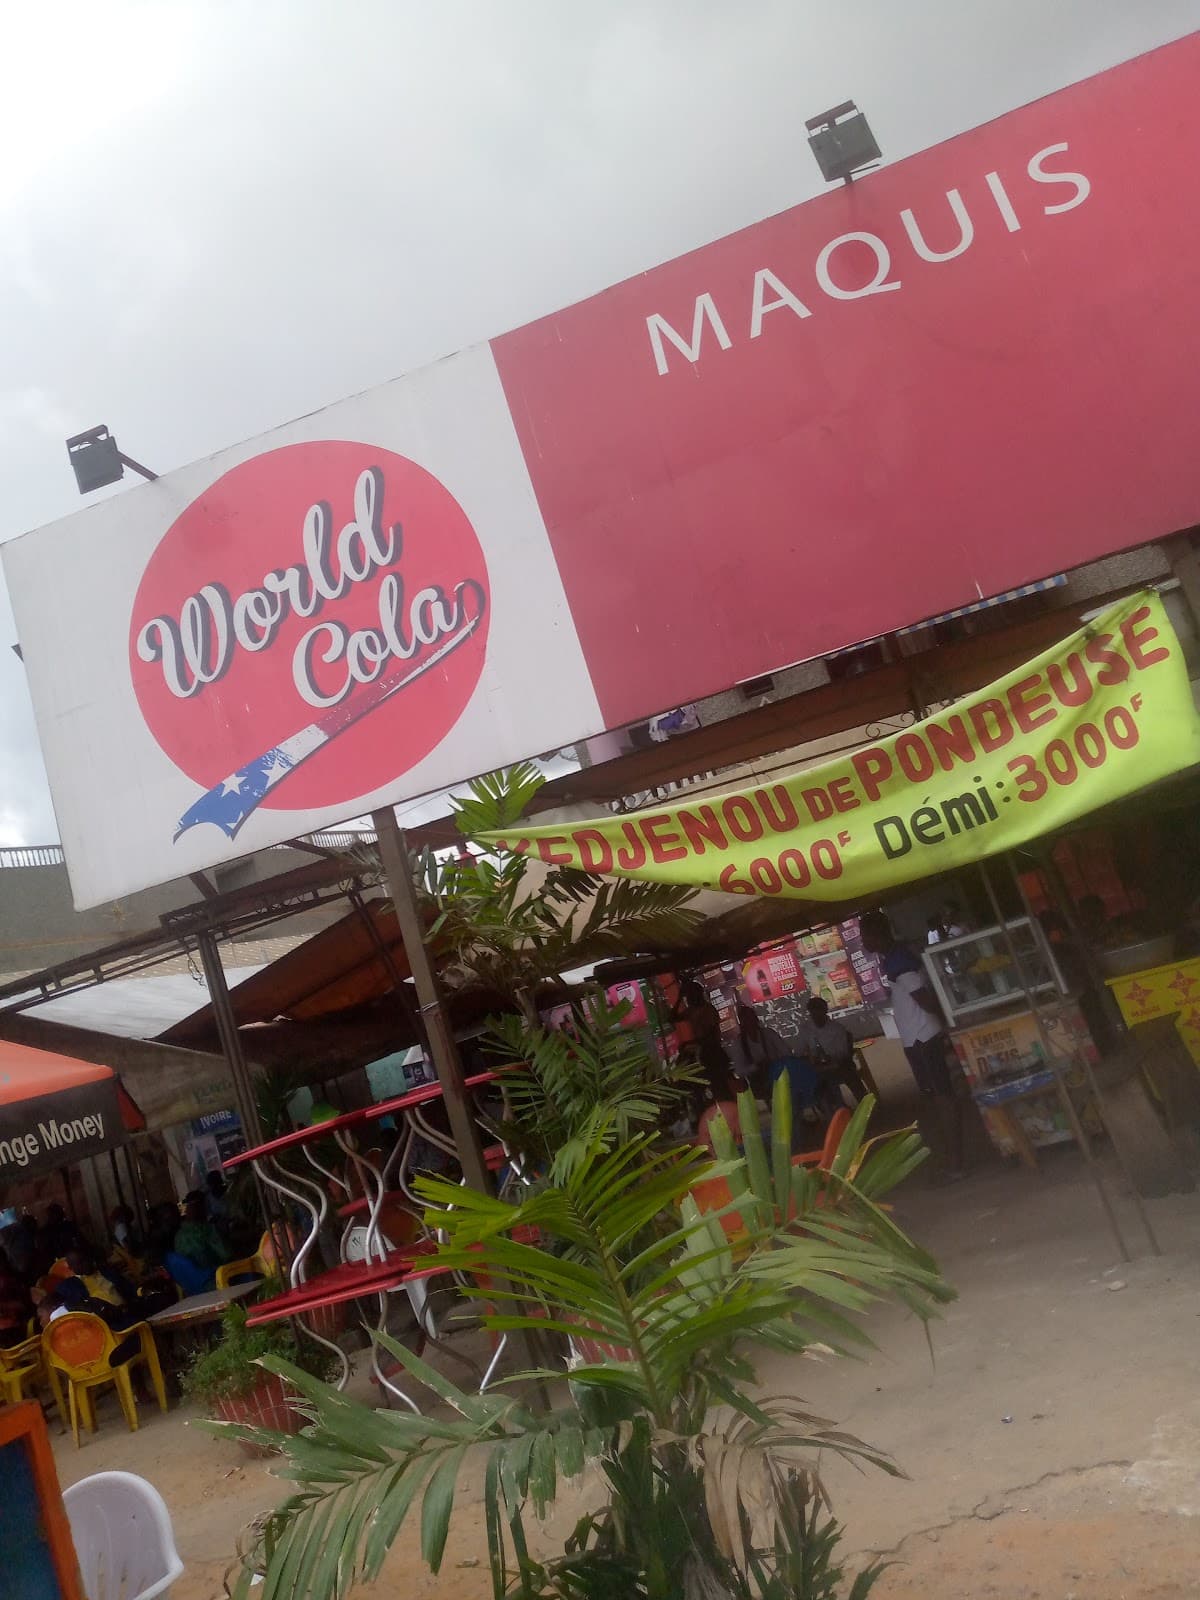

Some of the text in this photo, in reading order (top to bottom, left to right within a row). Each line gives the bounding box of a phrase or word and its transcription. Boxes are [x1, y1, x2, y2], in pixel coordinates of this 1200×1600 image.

[645, 142, 1092, 376] MAQUIS
[136, 467, 401, 698] World
[292, 574, 484, 708] Cola
[803, 776, 861, 823] DE
[850, 606, 1171, 801] PONDEUSE
[0, 1113, 105, 1166] nge Money
